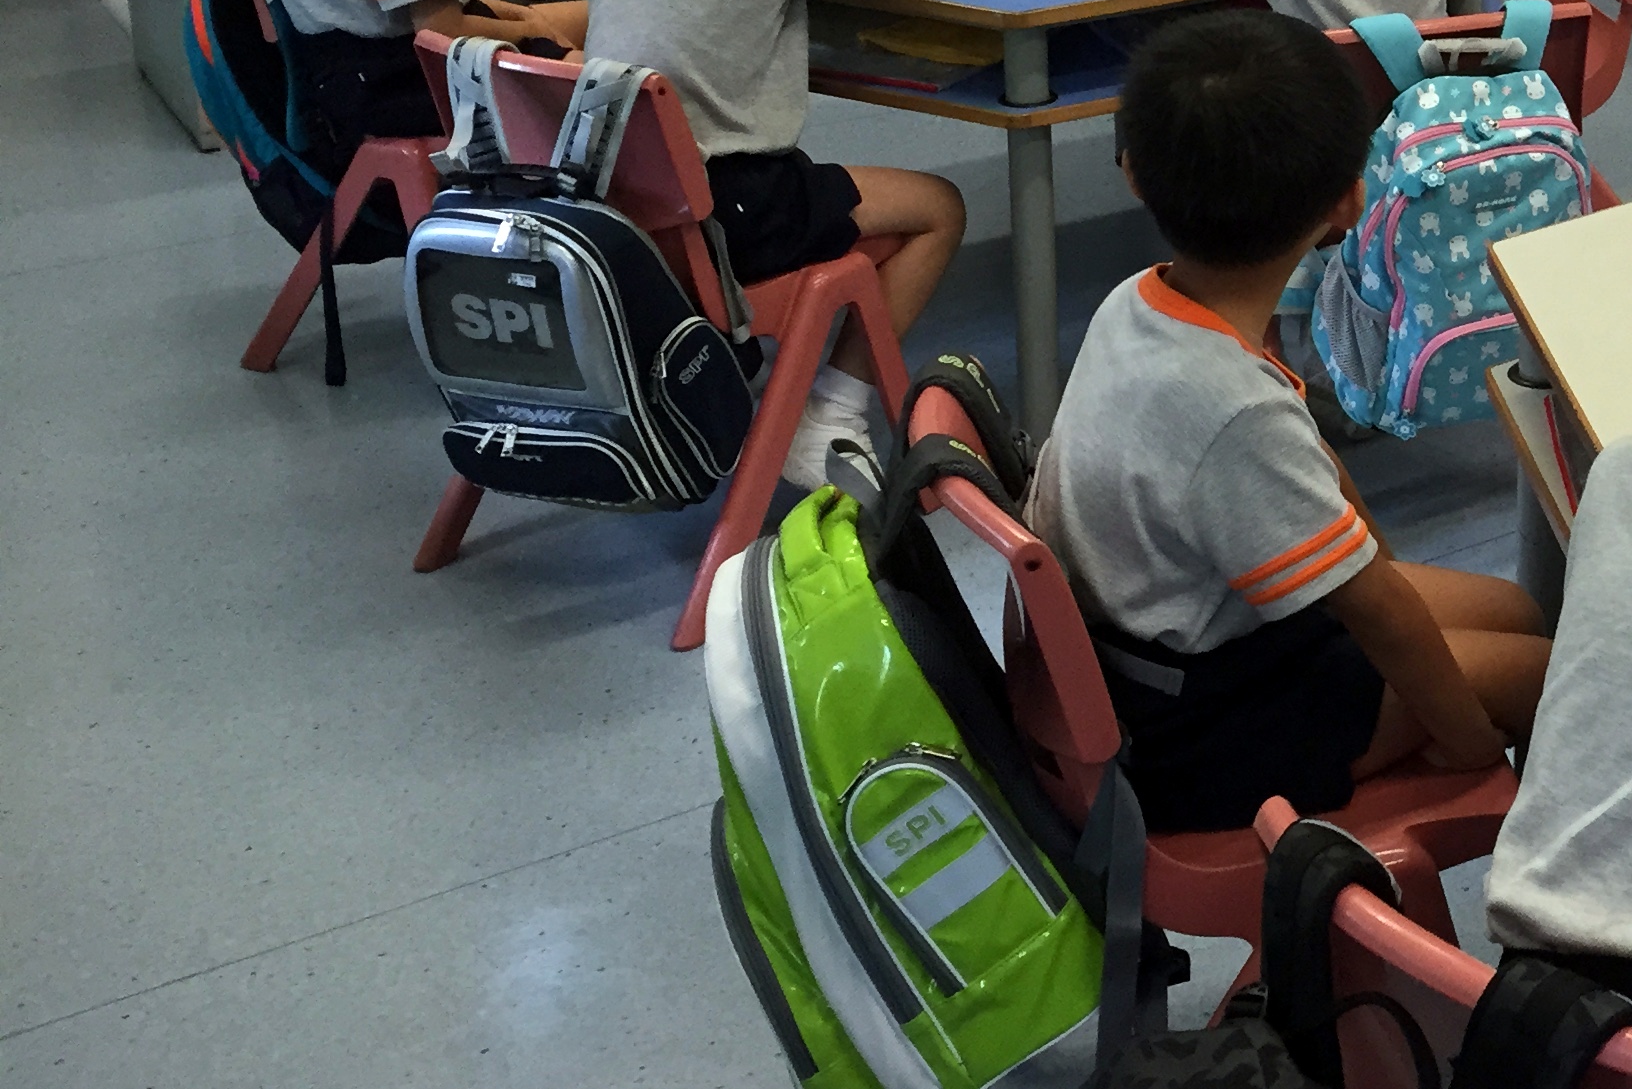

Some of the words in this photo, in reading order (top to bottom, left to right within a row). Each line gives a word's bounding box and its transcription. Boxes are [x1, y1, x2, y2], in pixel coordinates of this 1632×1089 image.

[451, 293, 554, 349] SPI
[938, 355, 1000, 413] SPI
[886, 805, 946, 857] SPI
